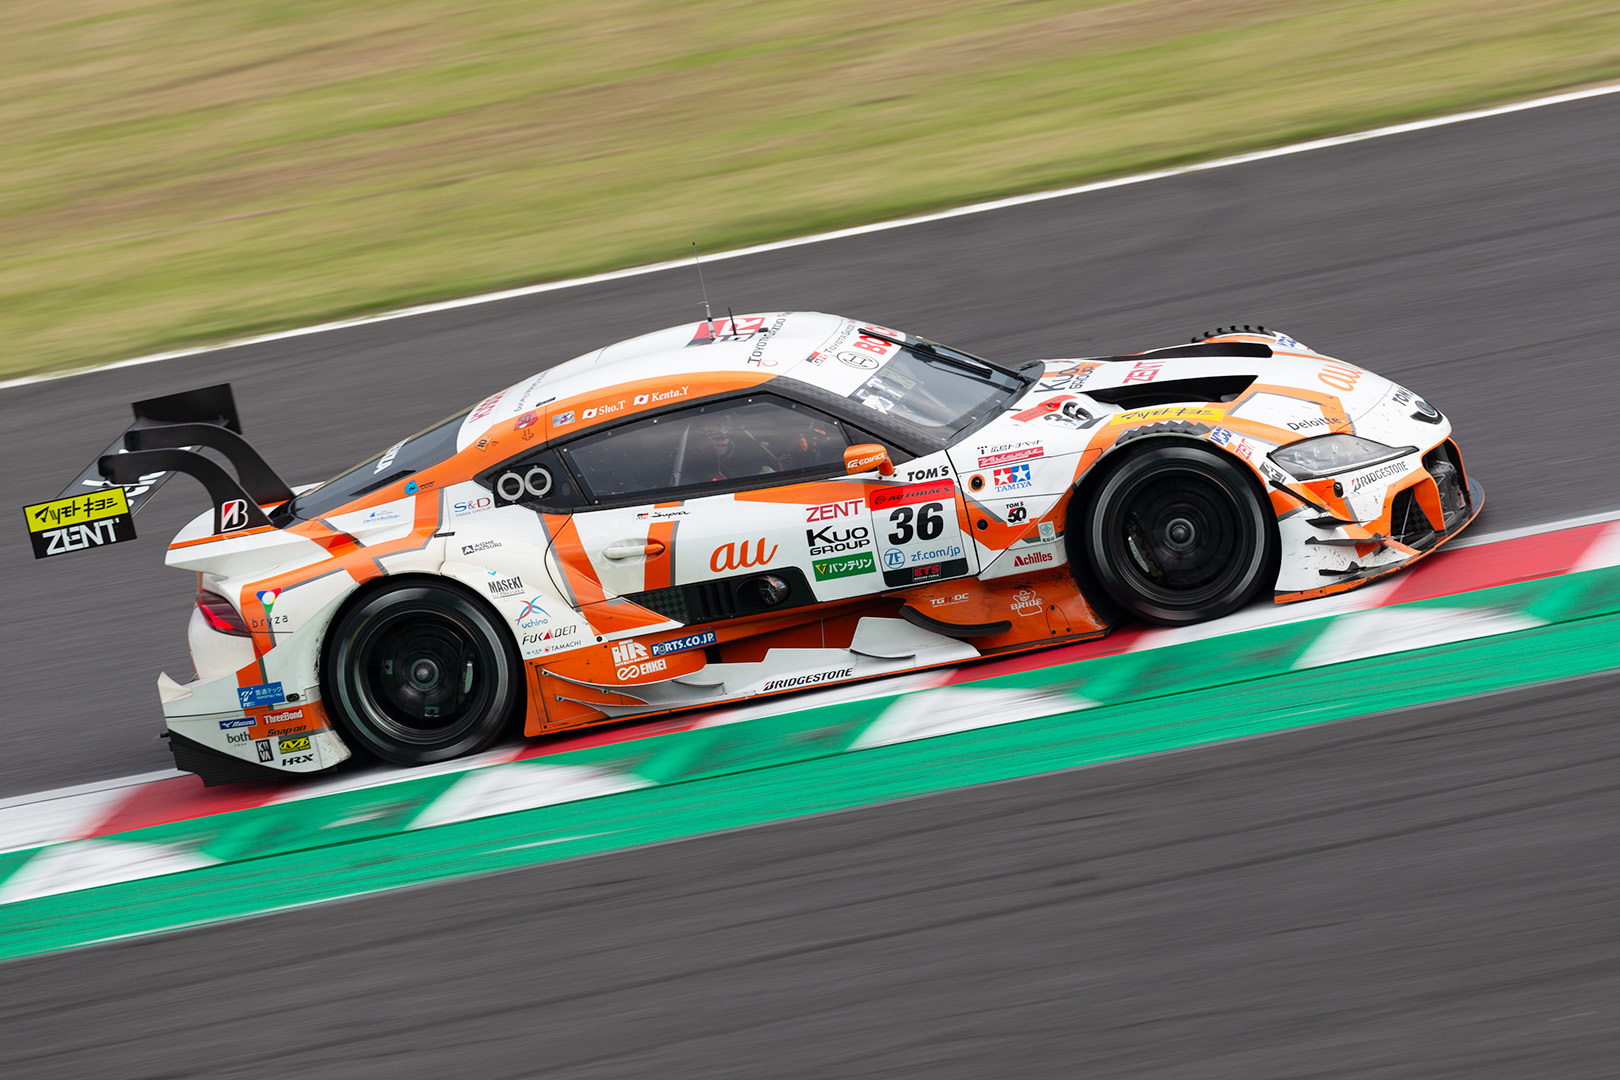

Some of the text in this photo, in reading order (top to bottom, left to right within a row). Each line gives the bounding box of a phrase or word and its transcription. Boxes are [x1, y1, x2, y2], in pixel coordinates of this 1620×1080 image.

[1122, 361, 1166, 384] ZENT
[1317, 363, 1364, 391] au
[651, 386, 690, 402] Kenta.Y
[599, 400, 626, 416] Sho.T
[1044, 401, 1094, 422] 36
[1287, 416, 1342, 431] Deloitte
[858, 452, 885, 465] EDIFICE
[907, 464, 949, 482] TOM'S
[1352, 461, 1409, 493] BRIDGESTONE
[888, 486, 950, 501] AUTOBACS
[995, 481, 1032, 493] TAMIYA
[34, 496, 118, 523] マツモトキヨシ
[454, 497, 491, 513] S&D
[806, 499, 864, 523] ZENT
[651, 510, 691, 519] Supra
[888, 502, 944, 546] 36
[42, 518, 121, 556] ZENT
[709, 537, 779, 573] au
[810, 538, 871, 556] GROUP
[884, 545, 961, 566] ZF zf.com/jp
[1014, 552, 1053, 567] Achilles
[828, 557, 872, 574] バンテリン
[914, 564, 940, 577] ETS
[488, 576, 524, 593] MASEKI
[930, 593, 969, 605] TGR-DC
[1010, 599, 1043, 610] BRIDE
[252, 614, 289, 629] bryza
[522, 619, 548, 629] uchino
[551, 640, 582, 651] TAMACHI
[640, 659, 667, 676] ENKEI
[763, 667, 852, 692] BRIDGESTONE
[263, 711, 304, 725] ThreeBond
[226, 731, 253, 744] both
[282, 753, 314, 767] HRX
